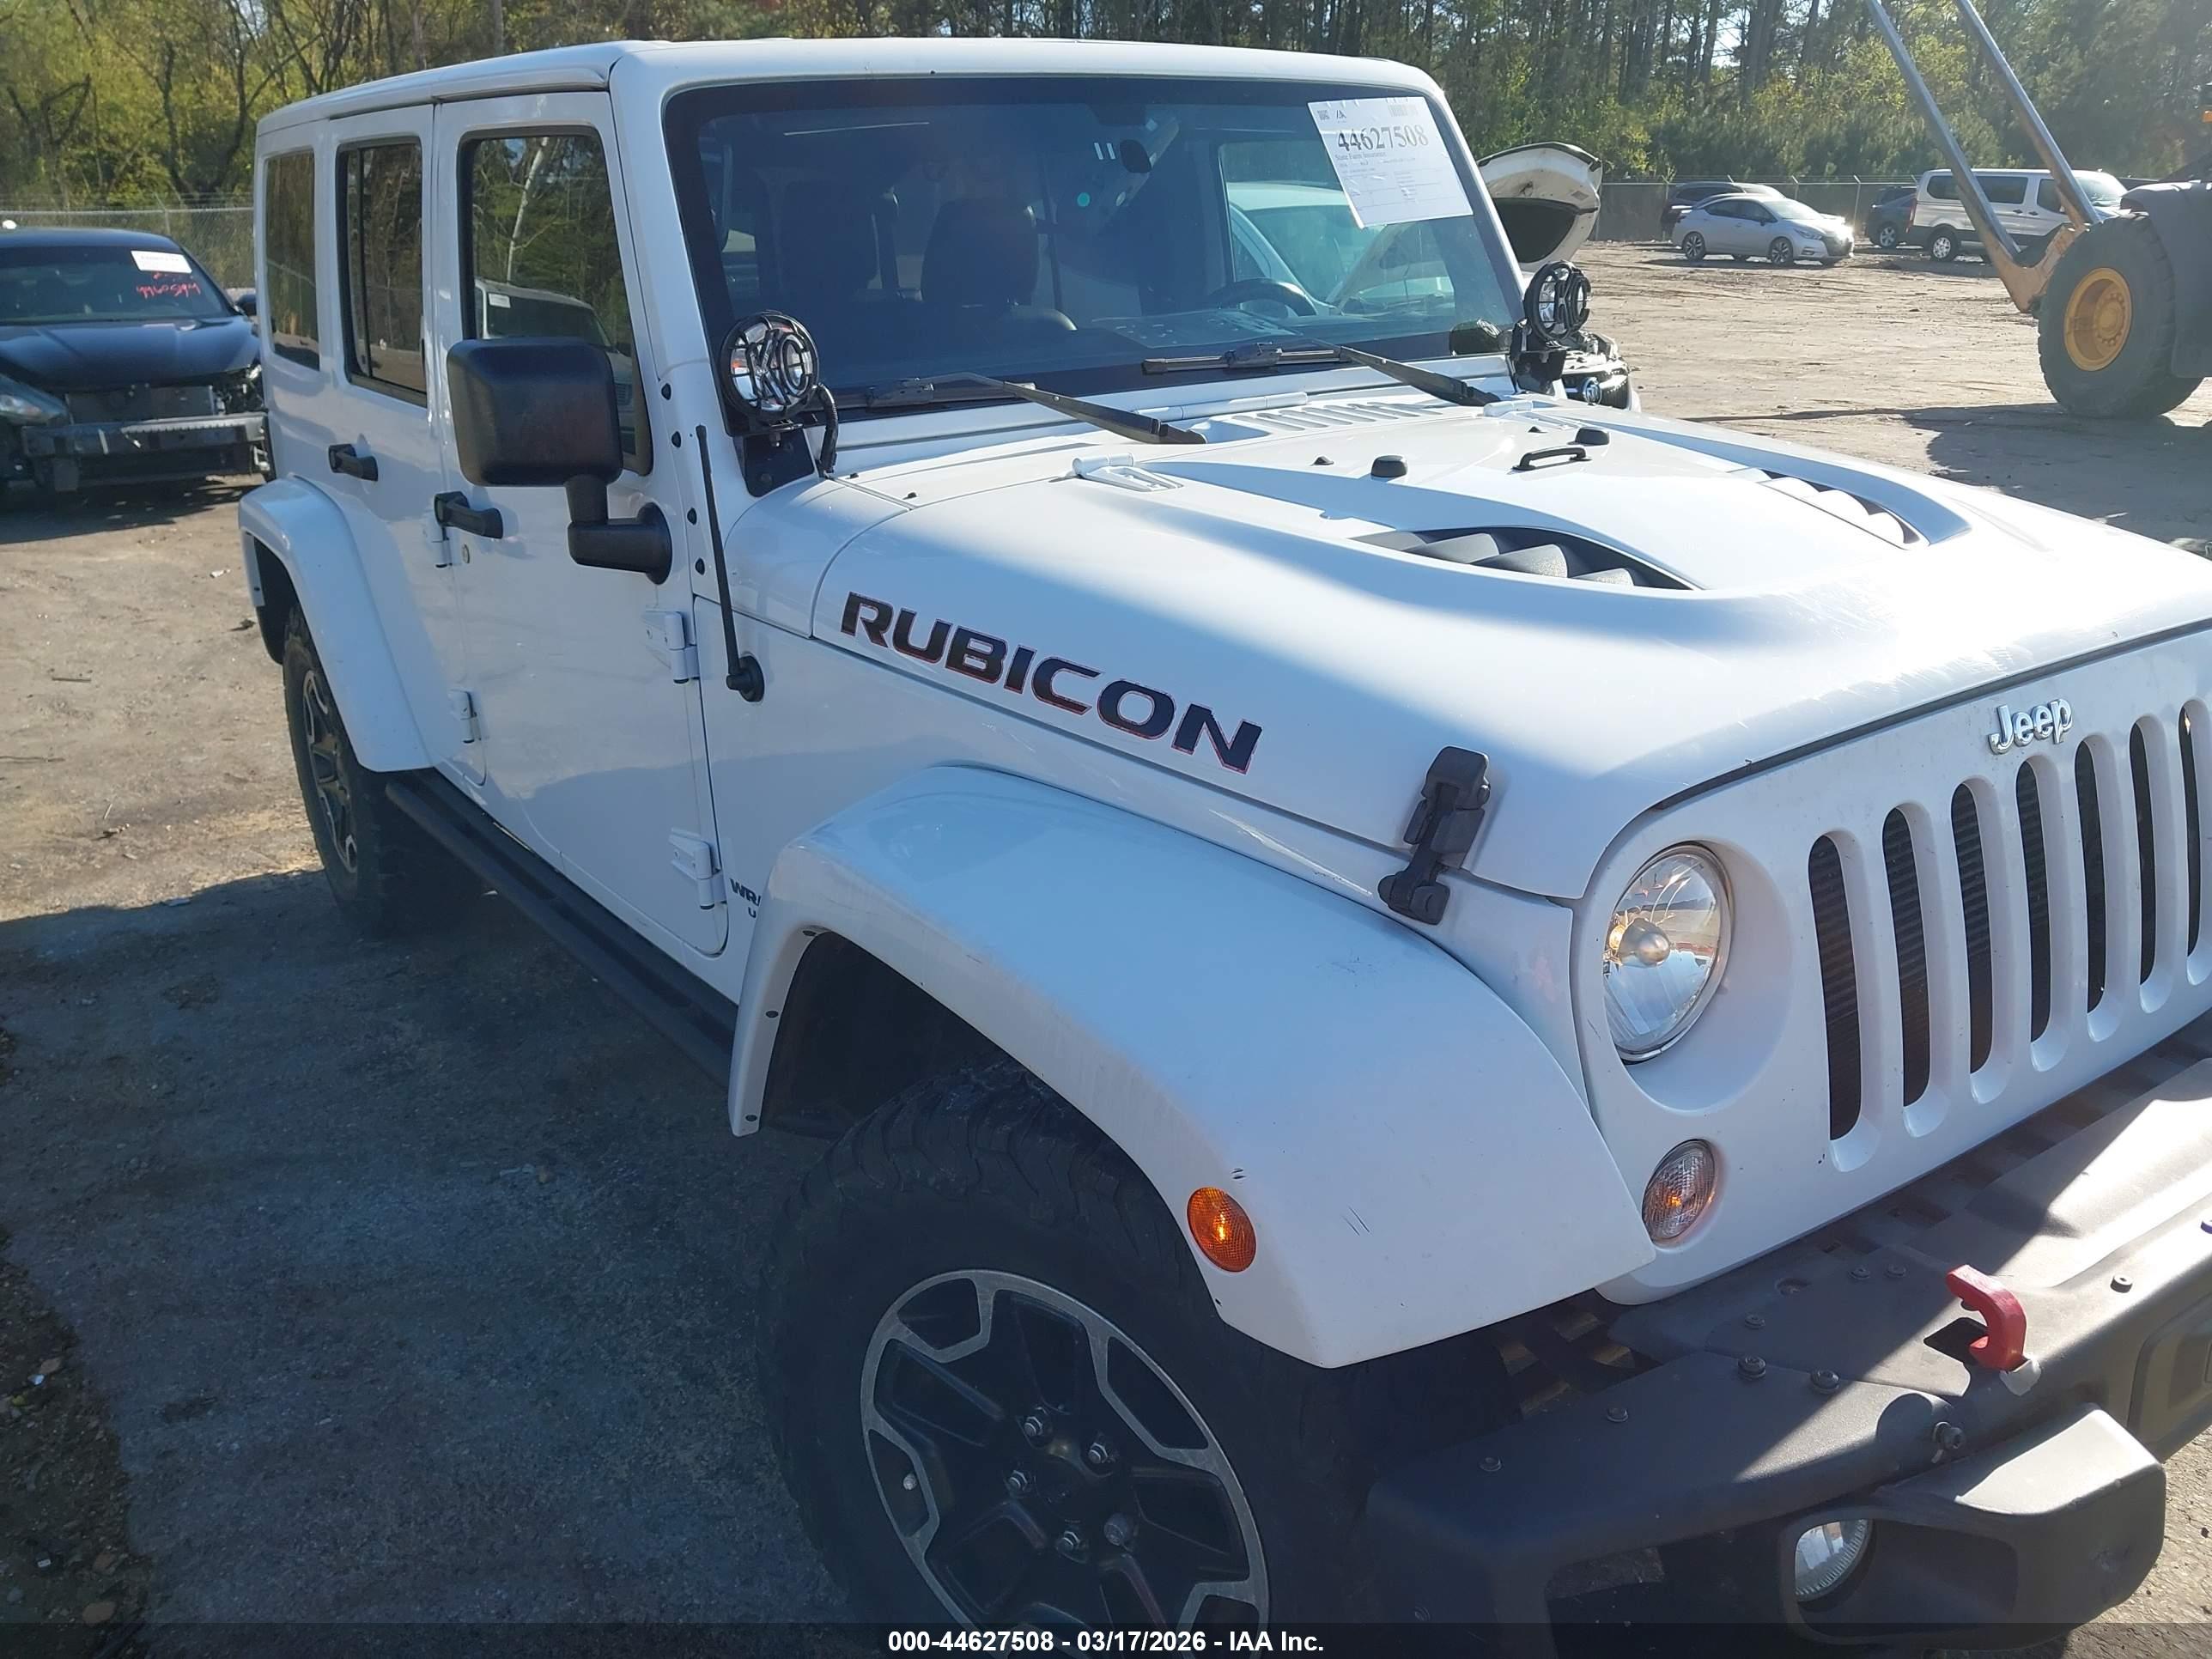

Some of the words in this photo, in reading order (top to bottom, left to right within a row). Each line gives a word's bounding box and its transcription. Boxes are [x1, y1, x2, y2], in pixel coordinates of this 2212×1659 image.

[1337, 125, 1429, 152] 44627508
[745, 328, 811, 405] KC
[840, 591, 1263, 775] RUBICON
[1988, 698, 2072, 755] Jeep
